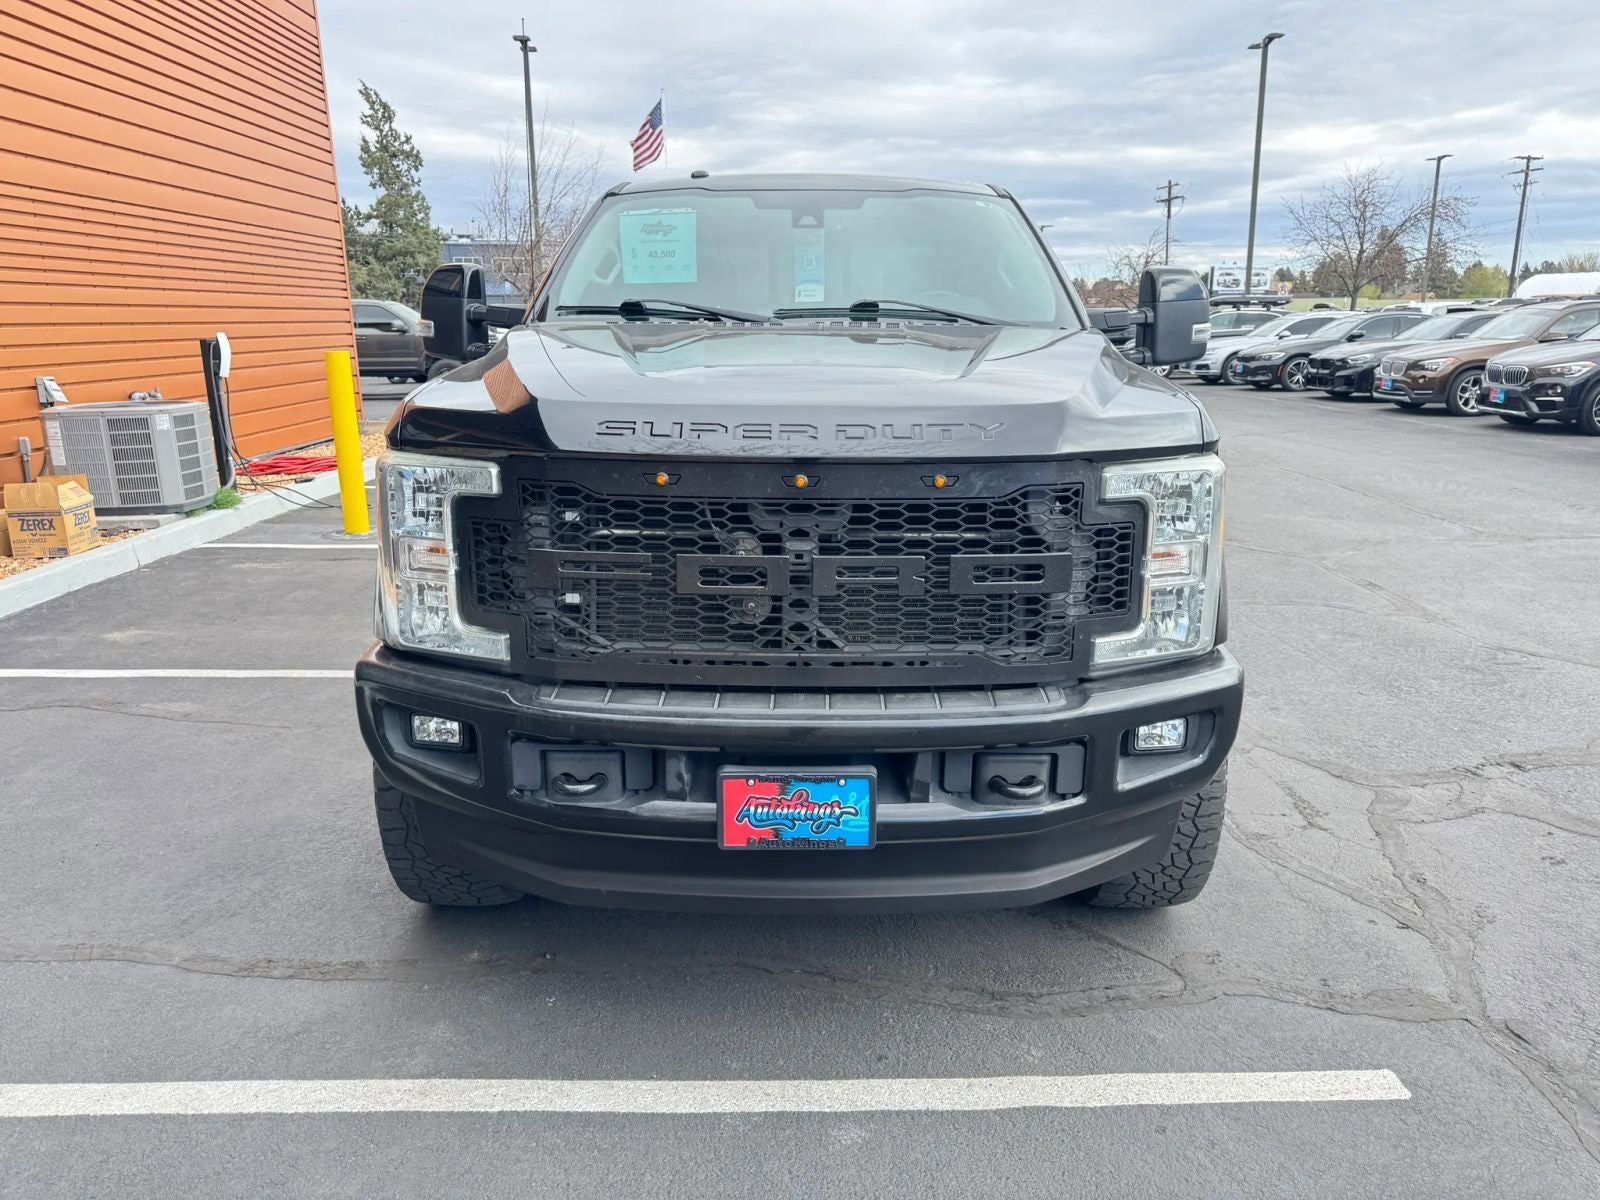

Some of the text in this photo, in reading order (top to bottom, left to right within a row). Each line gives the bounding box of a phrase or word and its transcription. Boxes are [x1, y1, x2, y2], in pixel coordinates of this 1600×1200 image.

[648, 249, 676, 259] 43,500
[596, 420, 1007, 441] SUPER DUTY
[18, 518, 56, 531] ZEREX
[73, 511, 90, 526] ZEREX
[528, 548, 1073, 596] FORD
